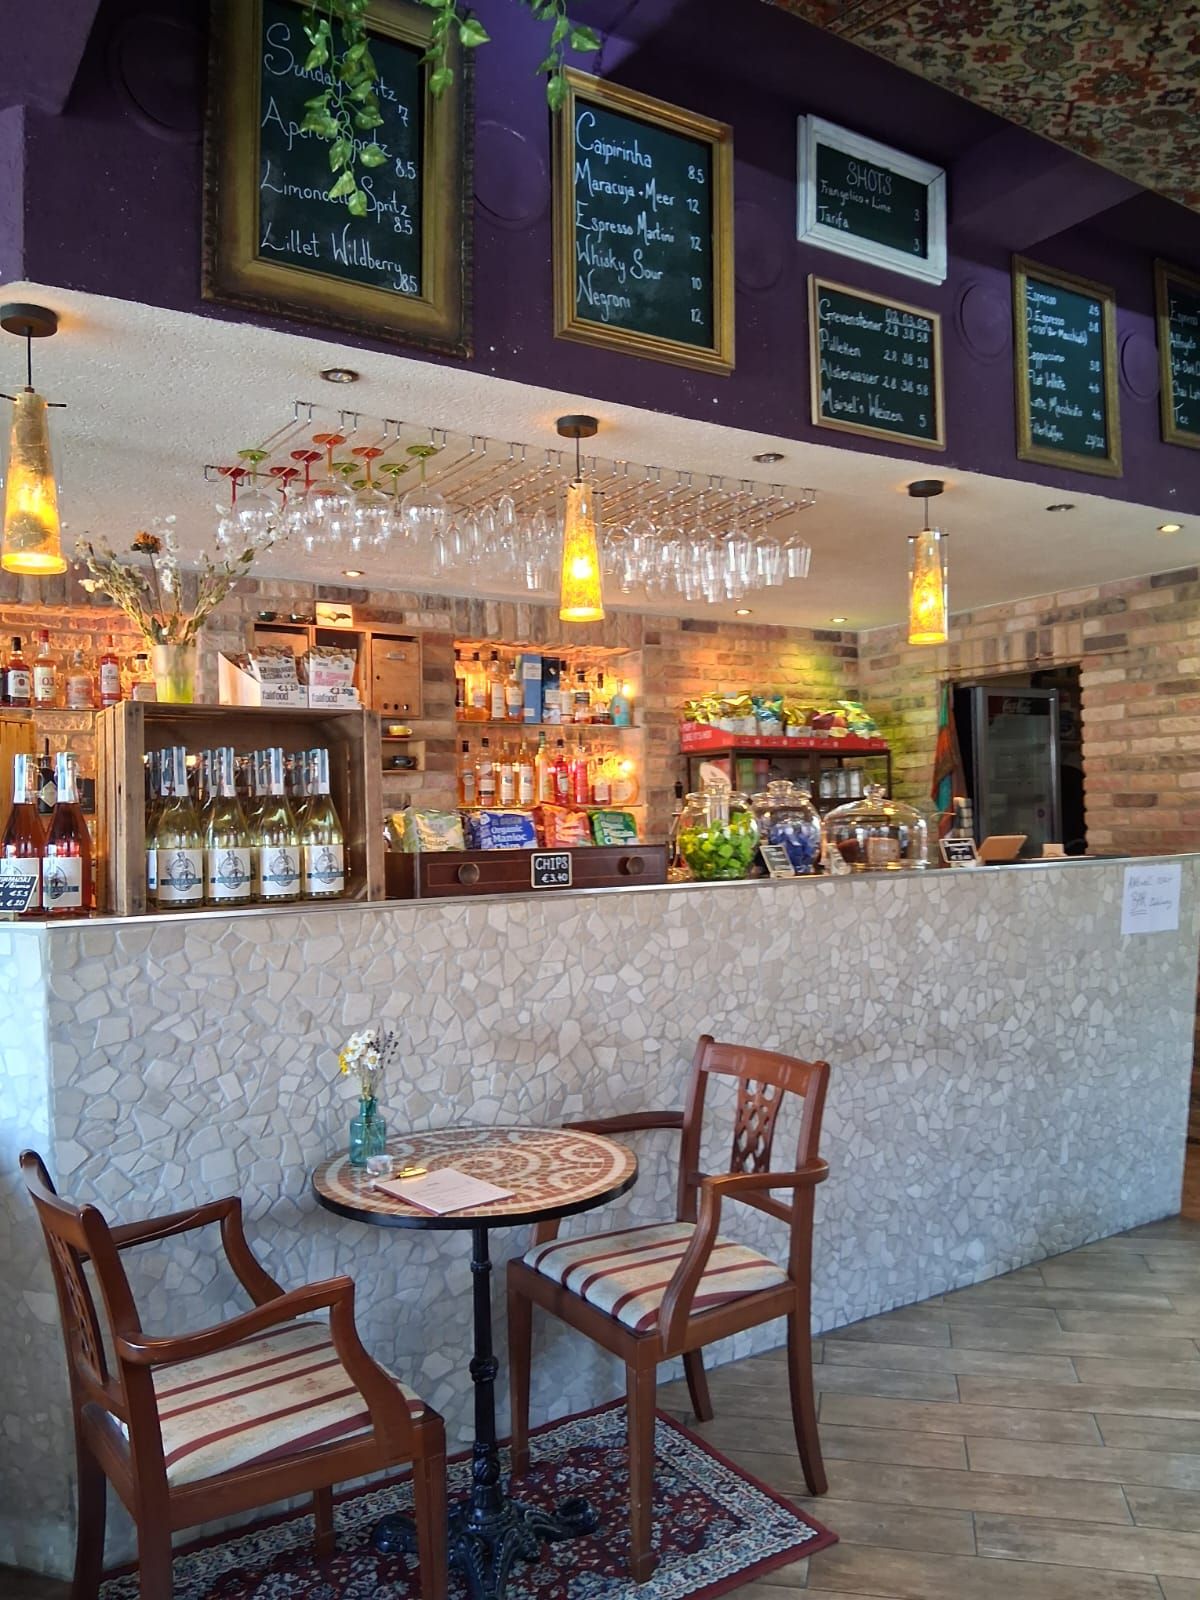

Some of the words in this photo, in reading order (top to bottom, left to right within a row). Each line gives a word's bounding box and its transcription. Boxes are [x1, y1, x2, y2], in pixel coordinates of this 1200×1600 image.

[398, 105, 409, 128] 7
[576, 111, 652, 168] Caipirinha
[846, 160, 892, 196] SHOTS
[687, 198, 701, 214] 12
[914, 208, 921, 222] 3
[576, 200, 634, 243] Espresso
[637, 211, 675, 246] Martini
[690, 235, 702, 252] 12
[818, 205, 849, 229] Tarifa
[913, 238, 920, 252] 3
[261, 221, 320, 259] Lillet
[331, 222, 402, 290] Wildberry
[576, 234, 626, 284] Whisky
[629, 248, 664, 281] Sour
[691, 276, 703, 291] 10
[576, 269, 631, 322] Negroni
[690, 308, 705, 325] 12
[918, 414, 928, 428] 5
[491, 825, 523, 835] Organic
[492, 834, 527, 843] Manioc
[535, 856, 569, 871] CHIPS
